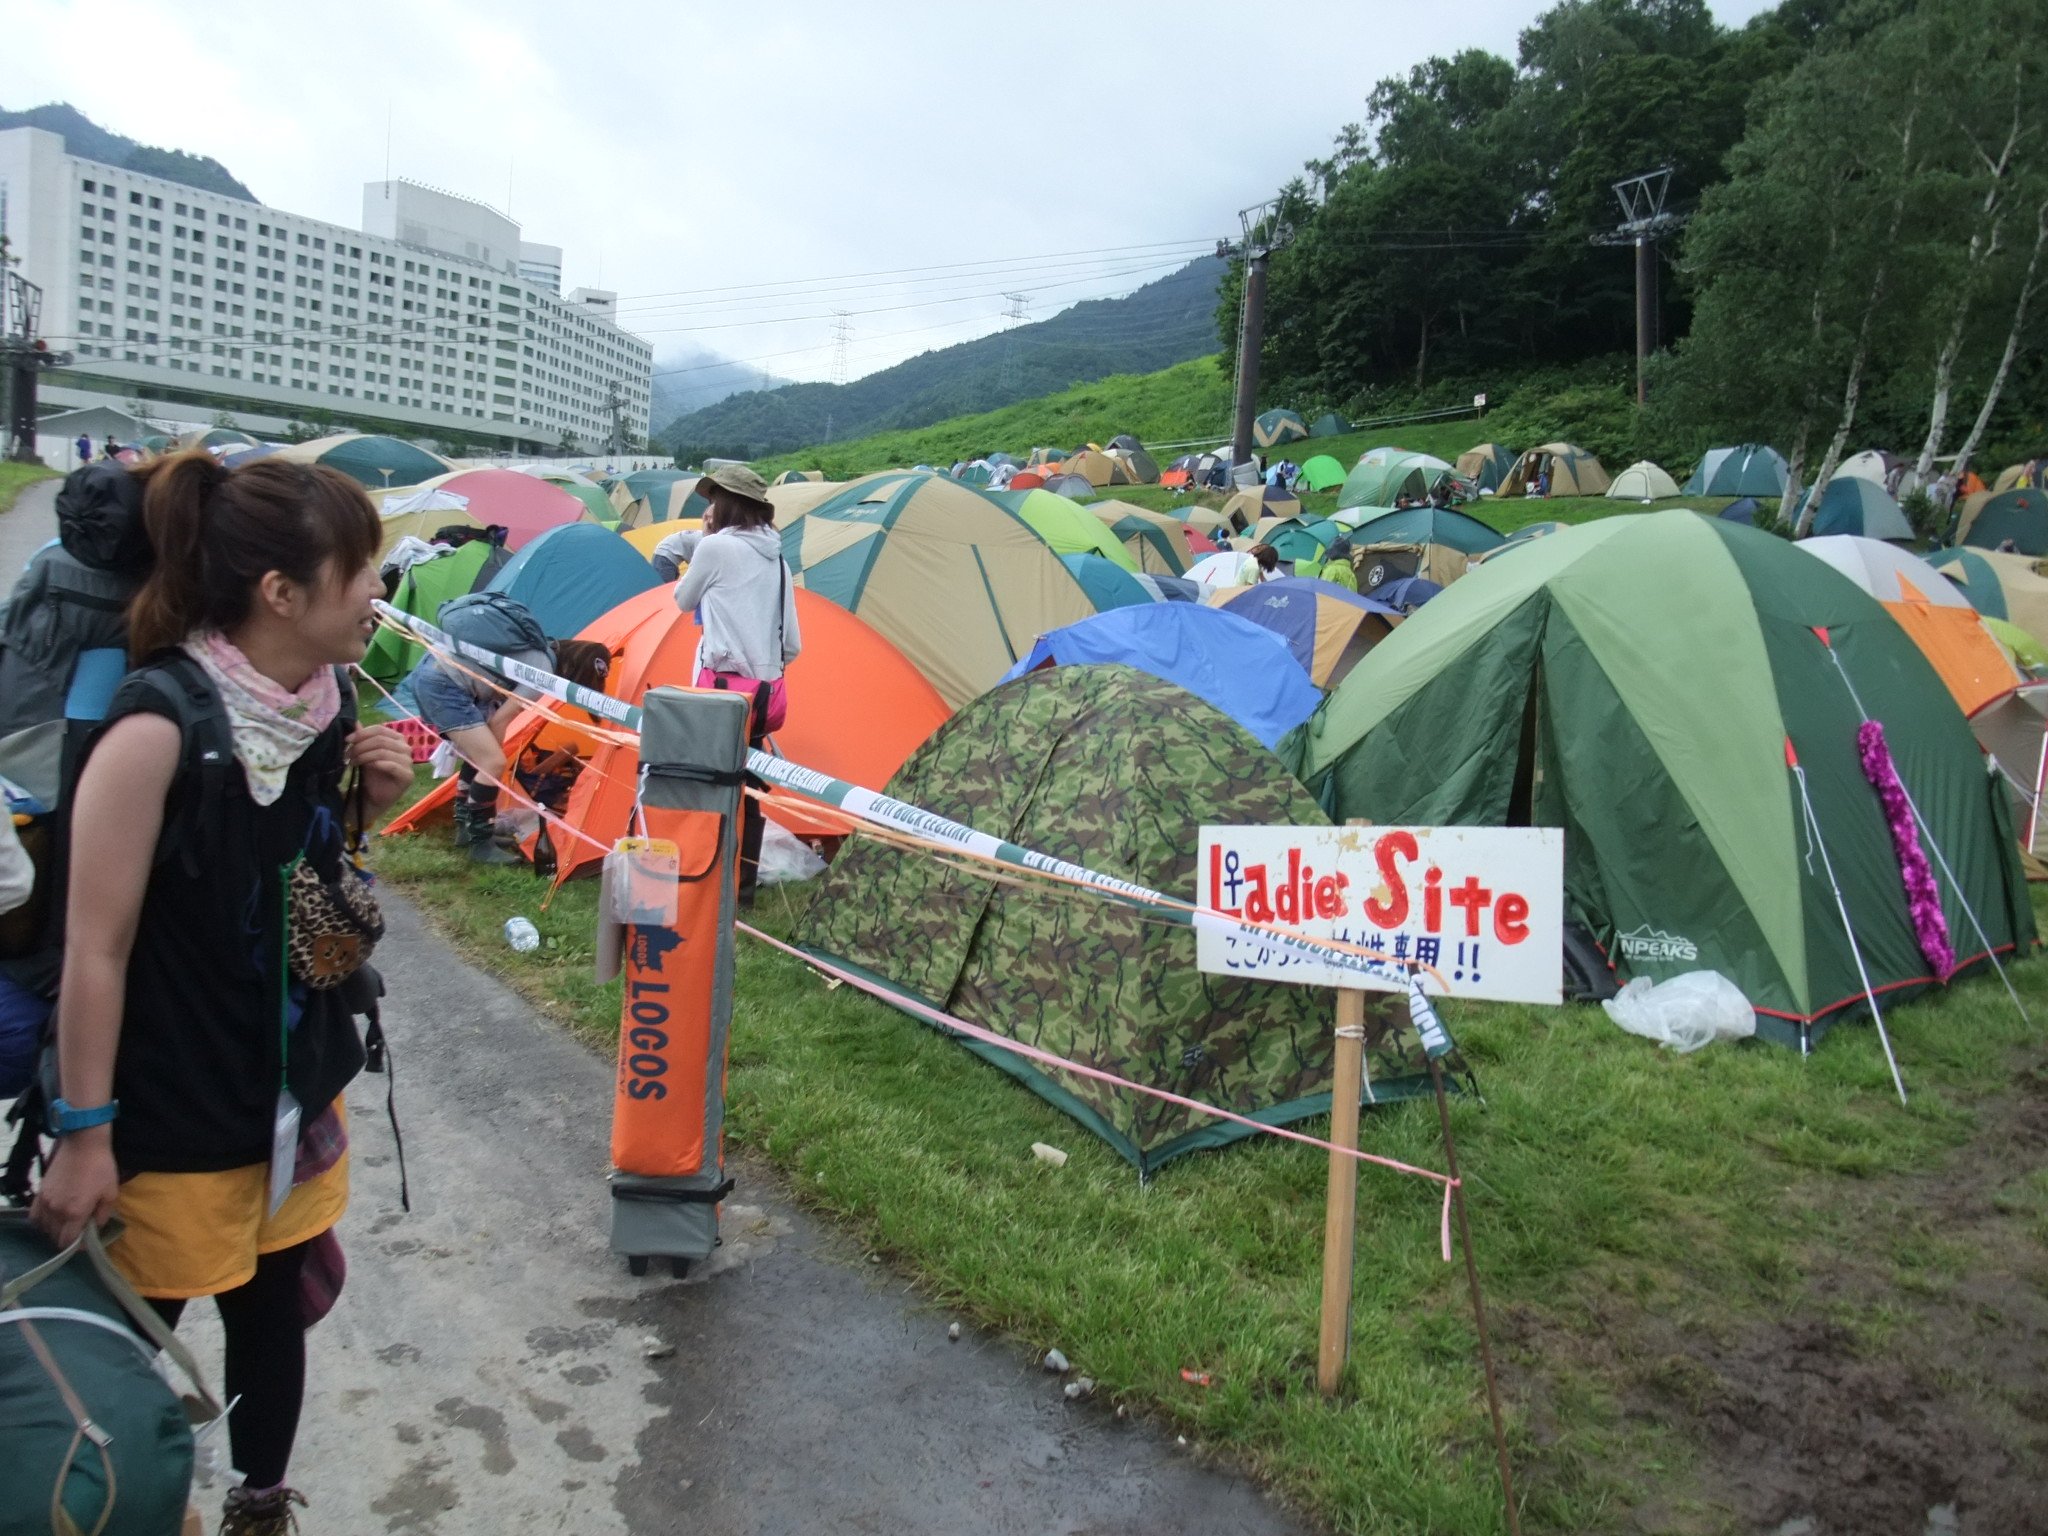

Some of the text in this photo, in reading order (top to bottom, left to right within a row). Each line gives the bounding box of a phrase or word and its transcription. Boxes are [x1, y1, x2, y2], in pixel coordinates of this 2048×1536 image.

[1209, 830, 1531, 946] Ladies Site
[636, 934, 649, 966] LOGOS
[627, 980, 671, 1101] LOGOS
